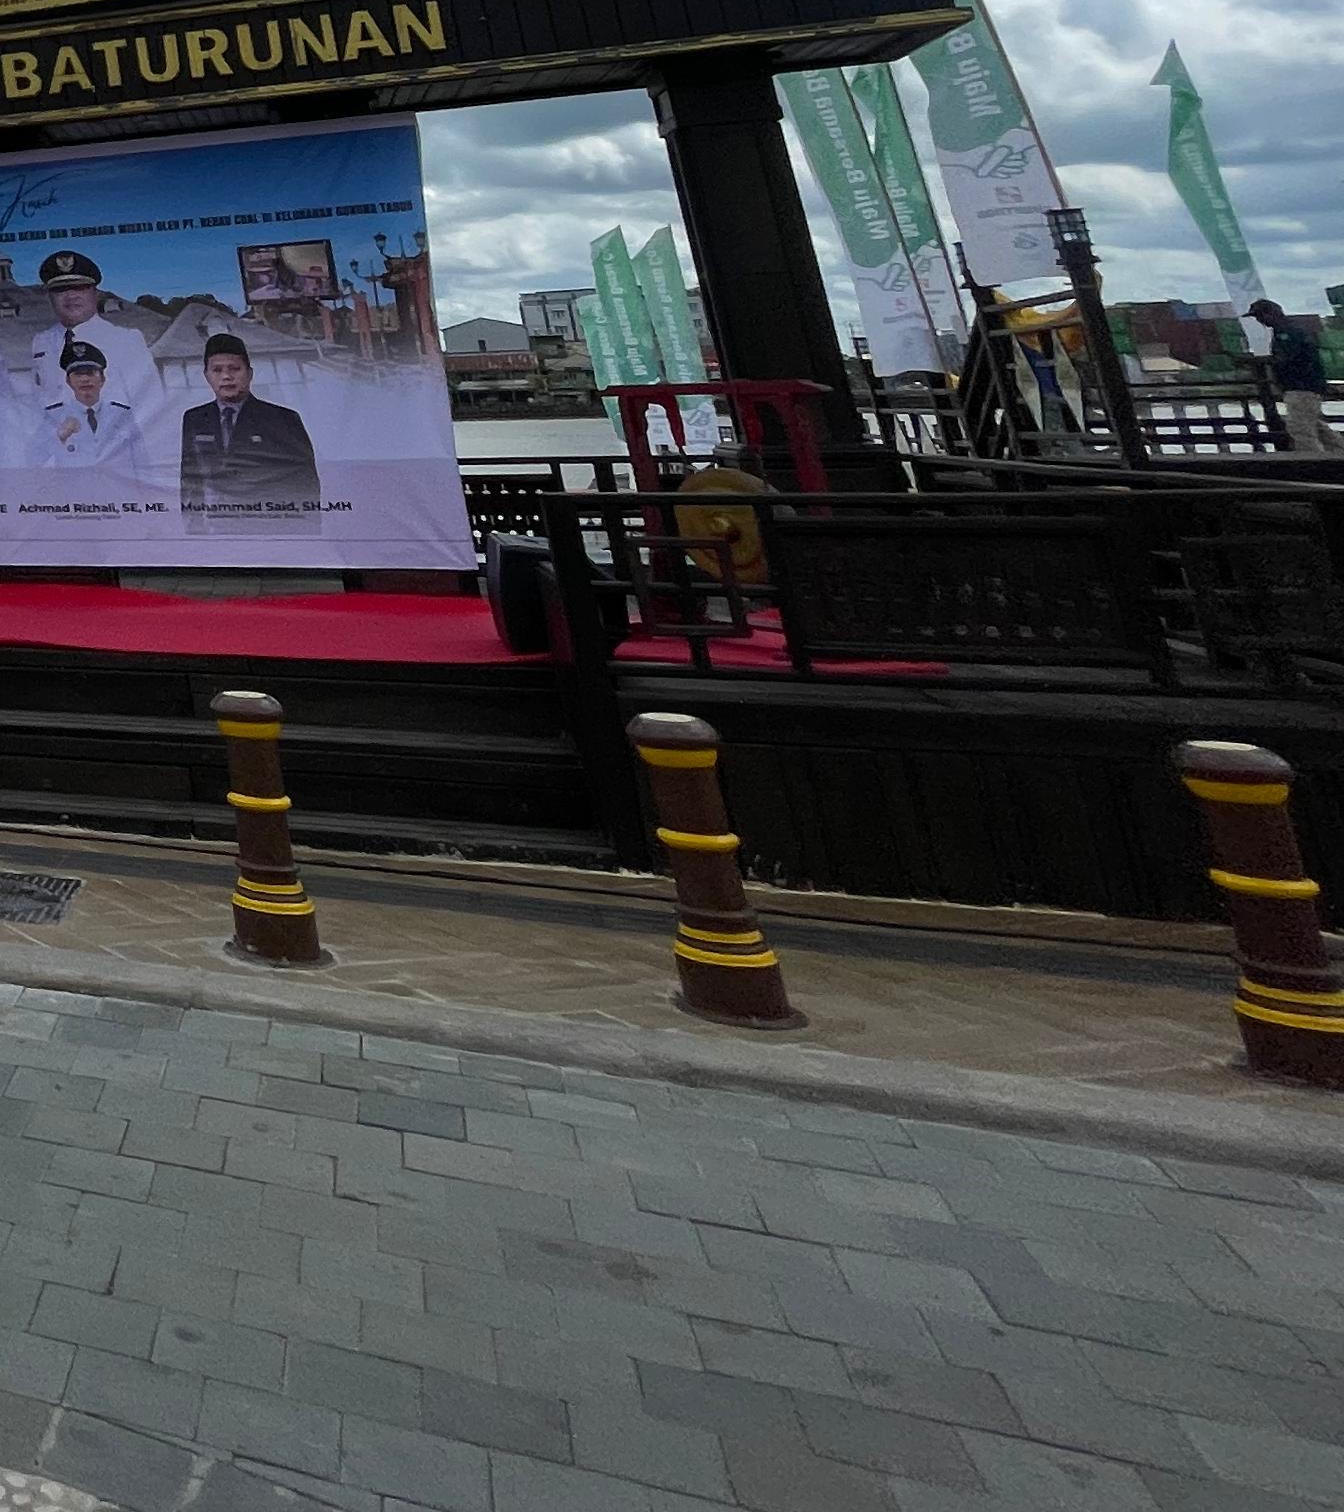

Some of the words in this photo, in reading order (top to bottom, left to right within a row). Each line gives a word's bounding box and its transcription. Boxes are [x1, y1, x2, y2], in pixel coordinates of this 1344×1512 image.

[0, 0, 448, 100] BATURUNAN
[18, 503, 70, 514] Achmad
[180, 501, 262, 513] Muhammad
